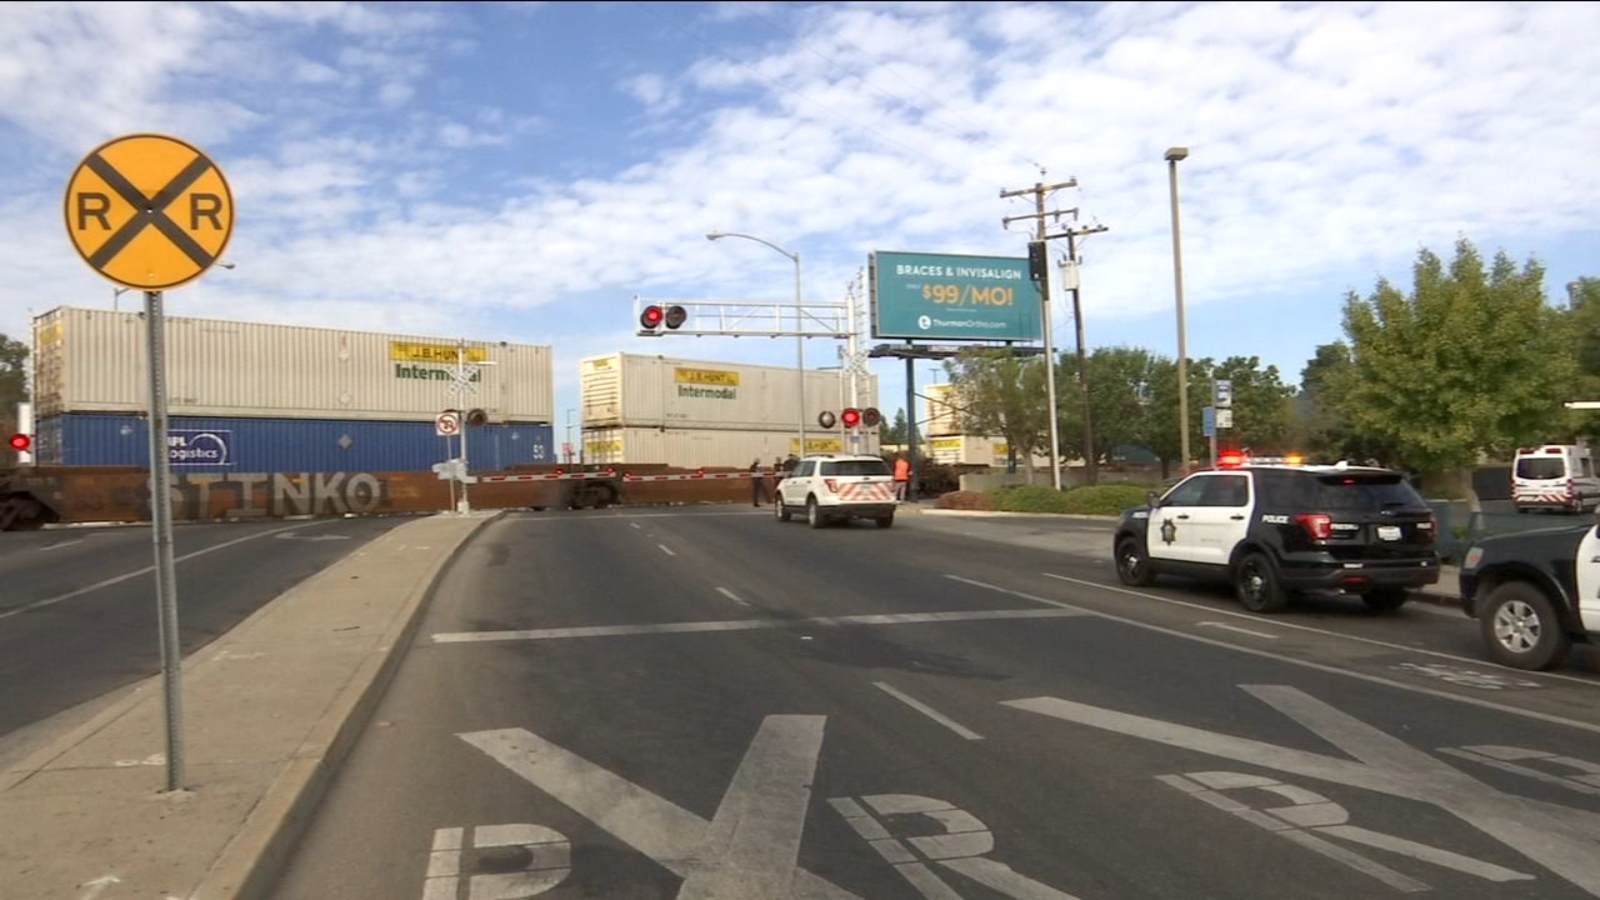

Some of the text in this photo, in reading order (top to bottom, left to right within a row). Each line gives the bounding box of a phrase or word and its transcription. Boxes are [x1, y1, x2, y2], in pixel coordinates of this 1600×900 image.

[77, 192, 223, 230] R R
[896, 265, 1021, 279] BRACES & INVISALIGN
[922, 283, 1013, 306] $99/MO!
[678, 384, 737, 400] Intermodal
[169, 448, 217, 460] ogistics
[147, 472, 381, 517] STINKO
[1262, 514, 1290, 524] POLICE
